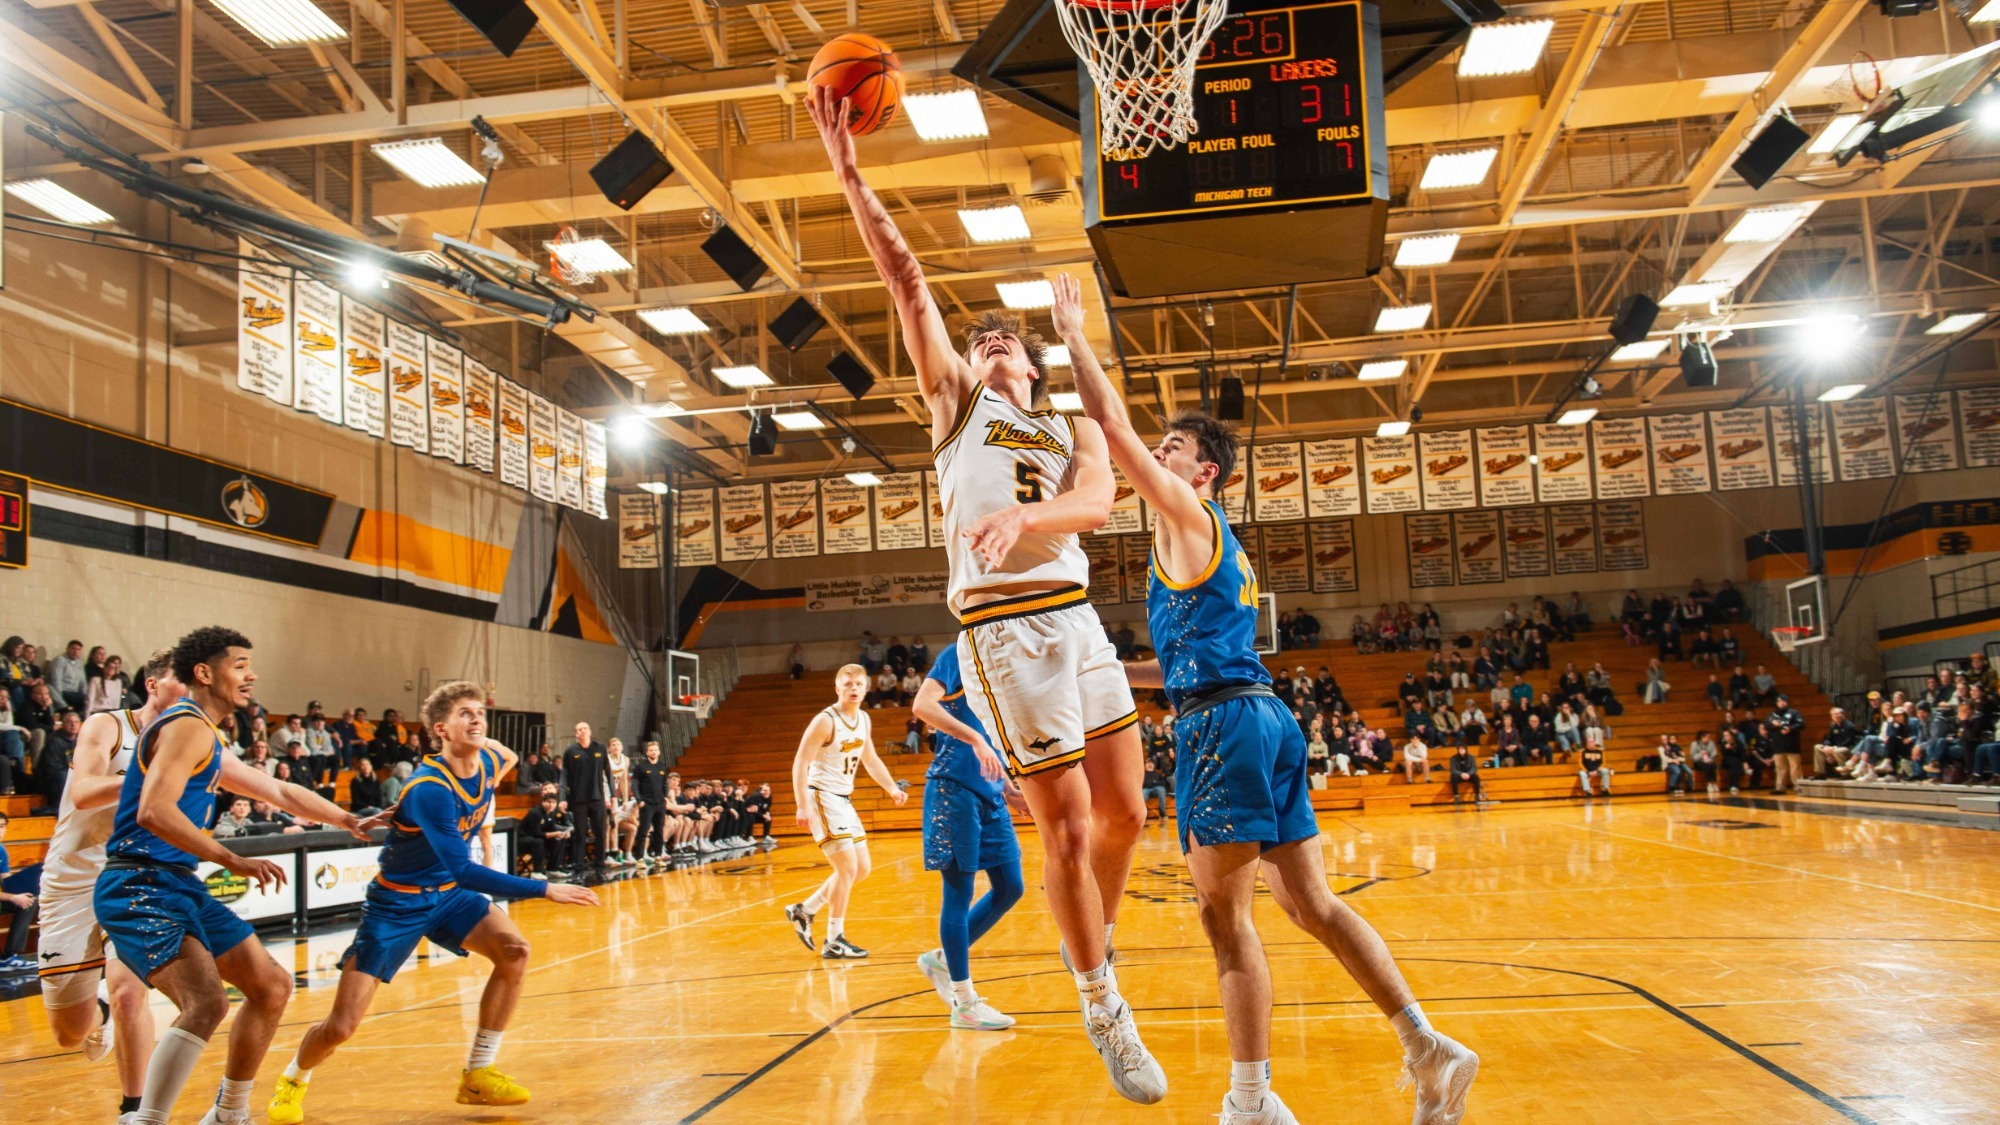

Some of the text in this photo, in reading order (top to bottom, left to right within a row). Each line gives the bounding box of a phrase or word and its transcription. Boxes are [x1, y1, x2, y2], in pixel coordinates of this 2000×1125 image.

[1270, 58, 1338, 81] LAKERS
[1204, 78, 1251, 94] PERIOD
[1230, 99, 1237, 124] 1
[1301, 84, 1351, 123] 31
[1317, 125, 1360, 142] FOULS
[1188, 134, 1276, 154] PLAYER FOUL
[1104, 145, 1147, 162] FOULS
[1335, 142, 1353, 169] 7
[1120, 165, 1138, 189] 4
[1194, 186, 1273, 202] MICHIGAN TECH
[242, 297, 285, 329] Huskies
[297, 321, 336, 351] Huskies
[1661, 416, 1692, 424] Michigan
[1714, 418, 1763, 427] Technological
[1721, 411, 1754, 419] Michigan
[1538, 431, 1584, 440] Technological
[1595, 428, 1642, 437] Technological
[1653, 423, 1702, 432] Technological
[1721, 426, 1757, 435] University
[983, 419, 1070, 461] Huskies
[1423, 438, 1468, 447] Technological
[1481, 433, 1527, 442] Technological
[1545, 440, 1578, 448] University
[1661, 432, 1696, 441] University
[1308, 449, 1354, 457] Technological
[1366, 442, 1413, 451] Technological
[1657, 444, 1702, 464] Huskies
[1718, 438, 1764, 459] Huskies
[1254, 451, 1298, 460] Technological
[1373, 451, 1406, 460] University
[1542, 451, 1585, 473] Huskies
[1599, 449, 1643, 469] Huskies
[1260, 460, 1292, 468] University
[1427, 454, 1468, 476] Huskies
[1484, 454, 1526, 475] Huskies
[1013, 459, 1045, 504] 5
[1257, 472, 1299, 493] Huskies
[1311, 465, 1353, 486] Huskies
[1370, 465, 1413, 486] Huskies
[824, 486, 866, 494] Technological
[722, 495, 762, 504] Technological
[727, 503, 757, 511] University
[827, 505, 866, 524] Huskies
[881, 500, 919, 520] Huskies
[724, 514, 763, 534] Huskies
[775, 510, 814, 530] Huskies
[807, 580, 862, 591] Little Huskies
[893, 575, 916, 585] Little
[903, 583, 945, 593] Volleyball
[816, 587, 881, 599] Basketball Club
[853, 596, 891, 605] Fan Zone
